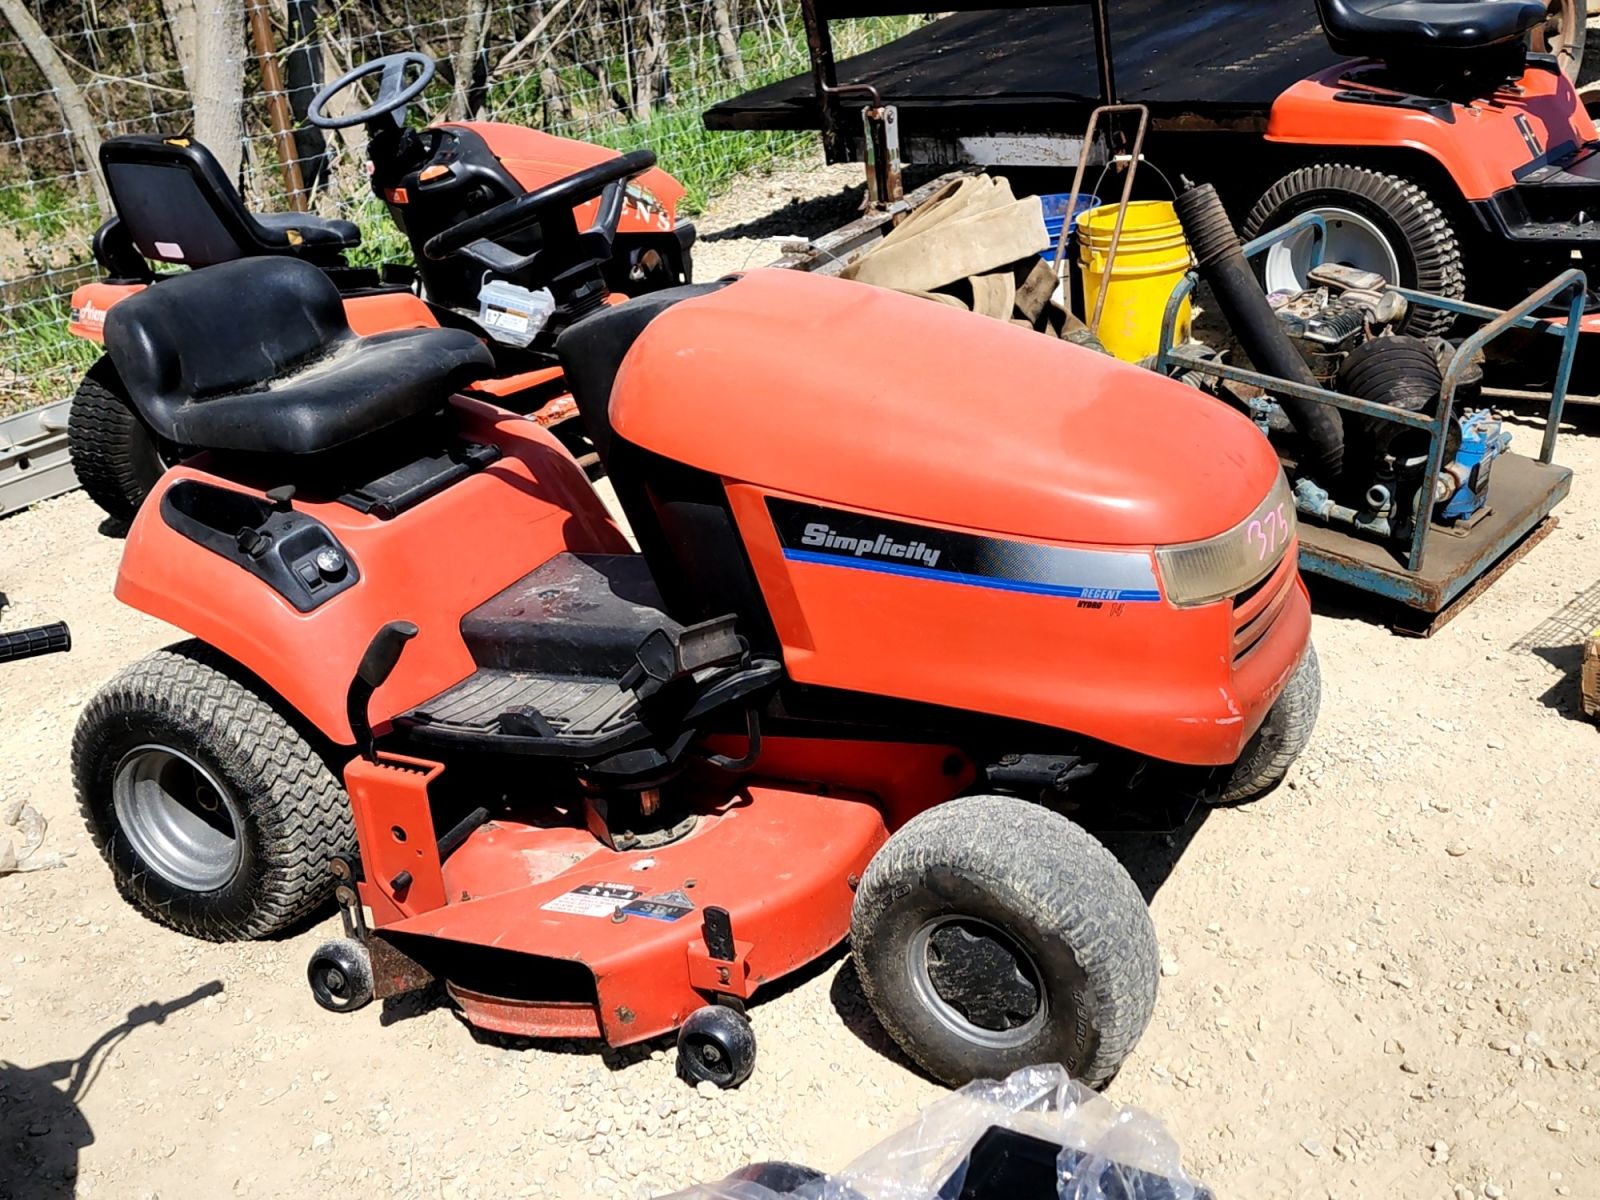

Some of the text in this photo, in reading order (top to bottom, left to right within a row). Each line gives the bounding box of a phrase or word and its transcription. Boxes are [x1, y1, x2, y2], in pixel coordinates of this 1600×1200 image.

[801, 522, 942, 567] Simplicity
[1247, 502, 1289, 561] 375
[1077, 600, 1103, 609] HYDRO
[1080, 588, 1122, 600] REGENT
